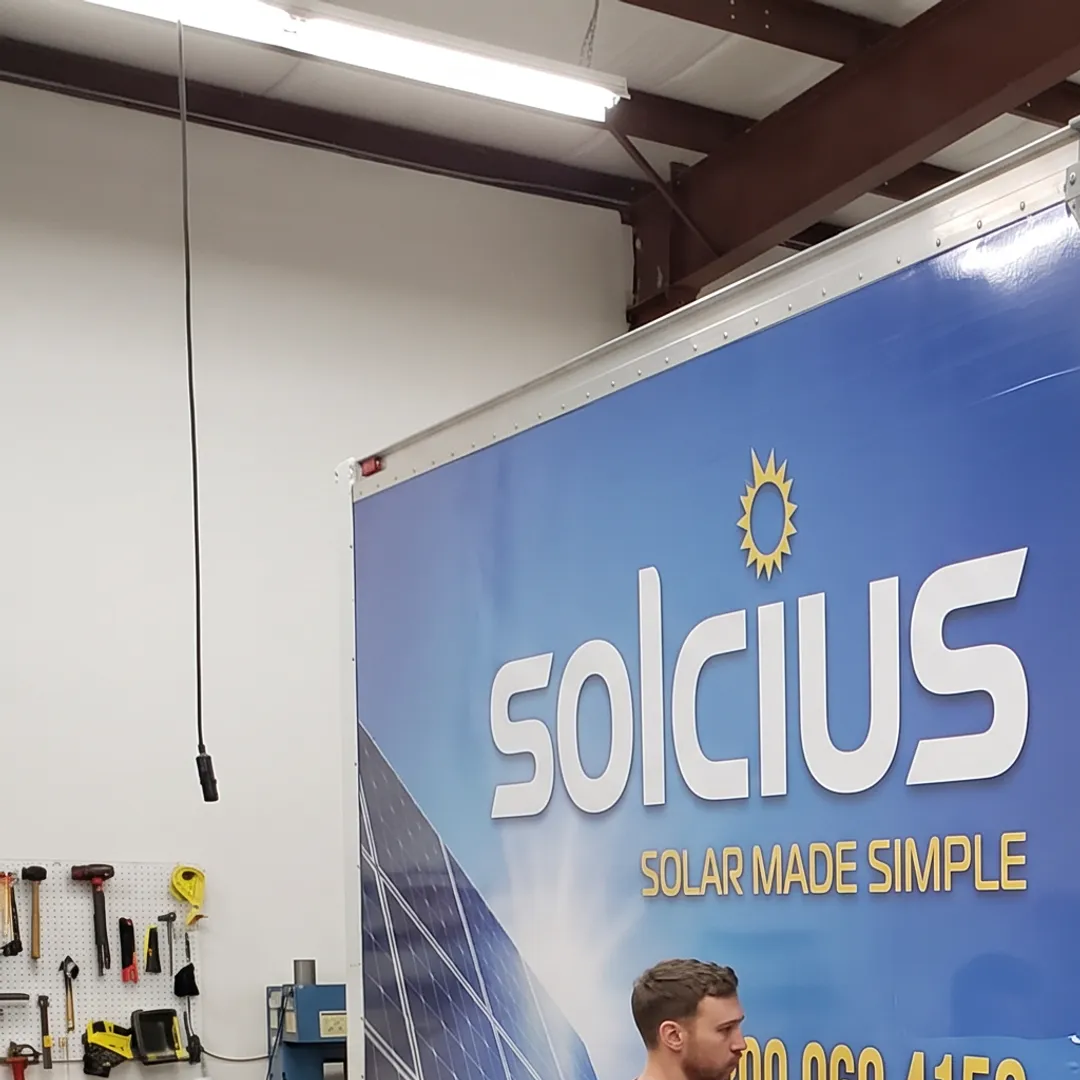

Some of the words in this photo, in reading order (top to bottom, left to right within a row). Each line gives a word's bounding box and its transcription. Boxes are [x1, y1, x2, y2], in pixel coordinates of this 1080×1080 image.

[490, 546, 1030, 819] solcius
[640, 844, 744, 898] SOLAR
[752, 840, 858, 895] MADE
[868, 830, 1028, 893] SIMPLE
